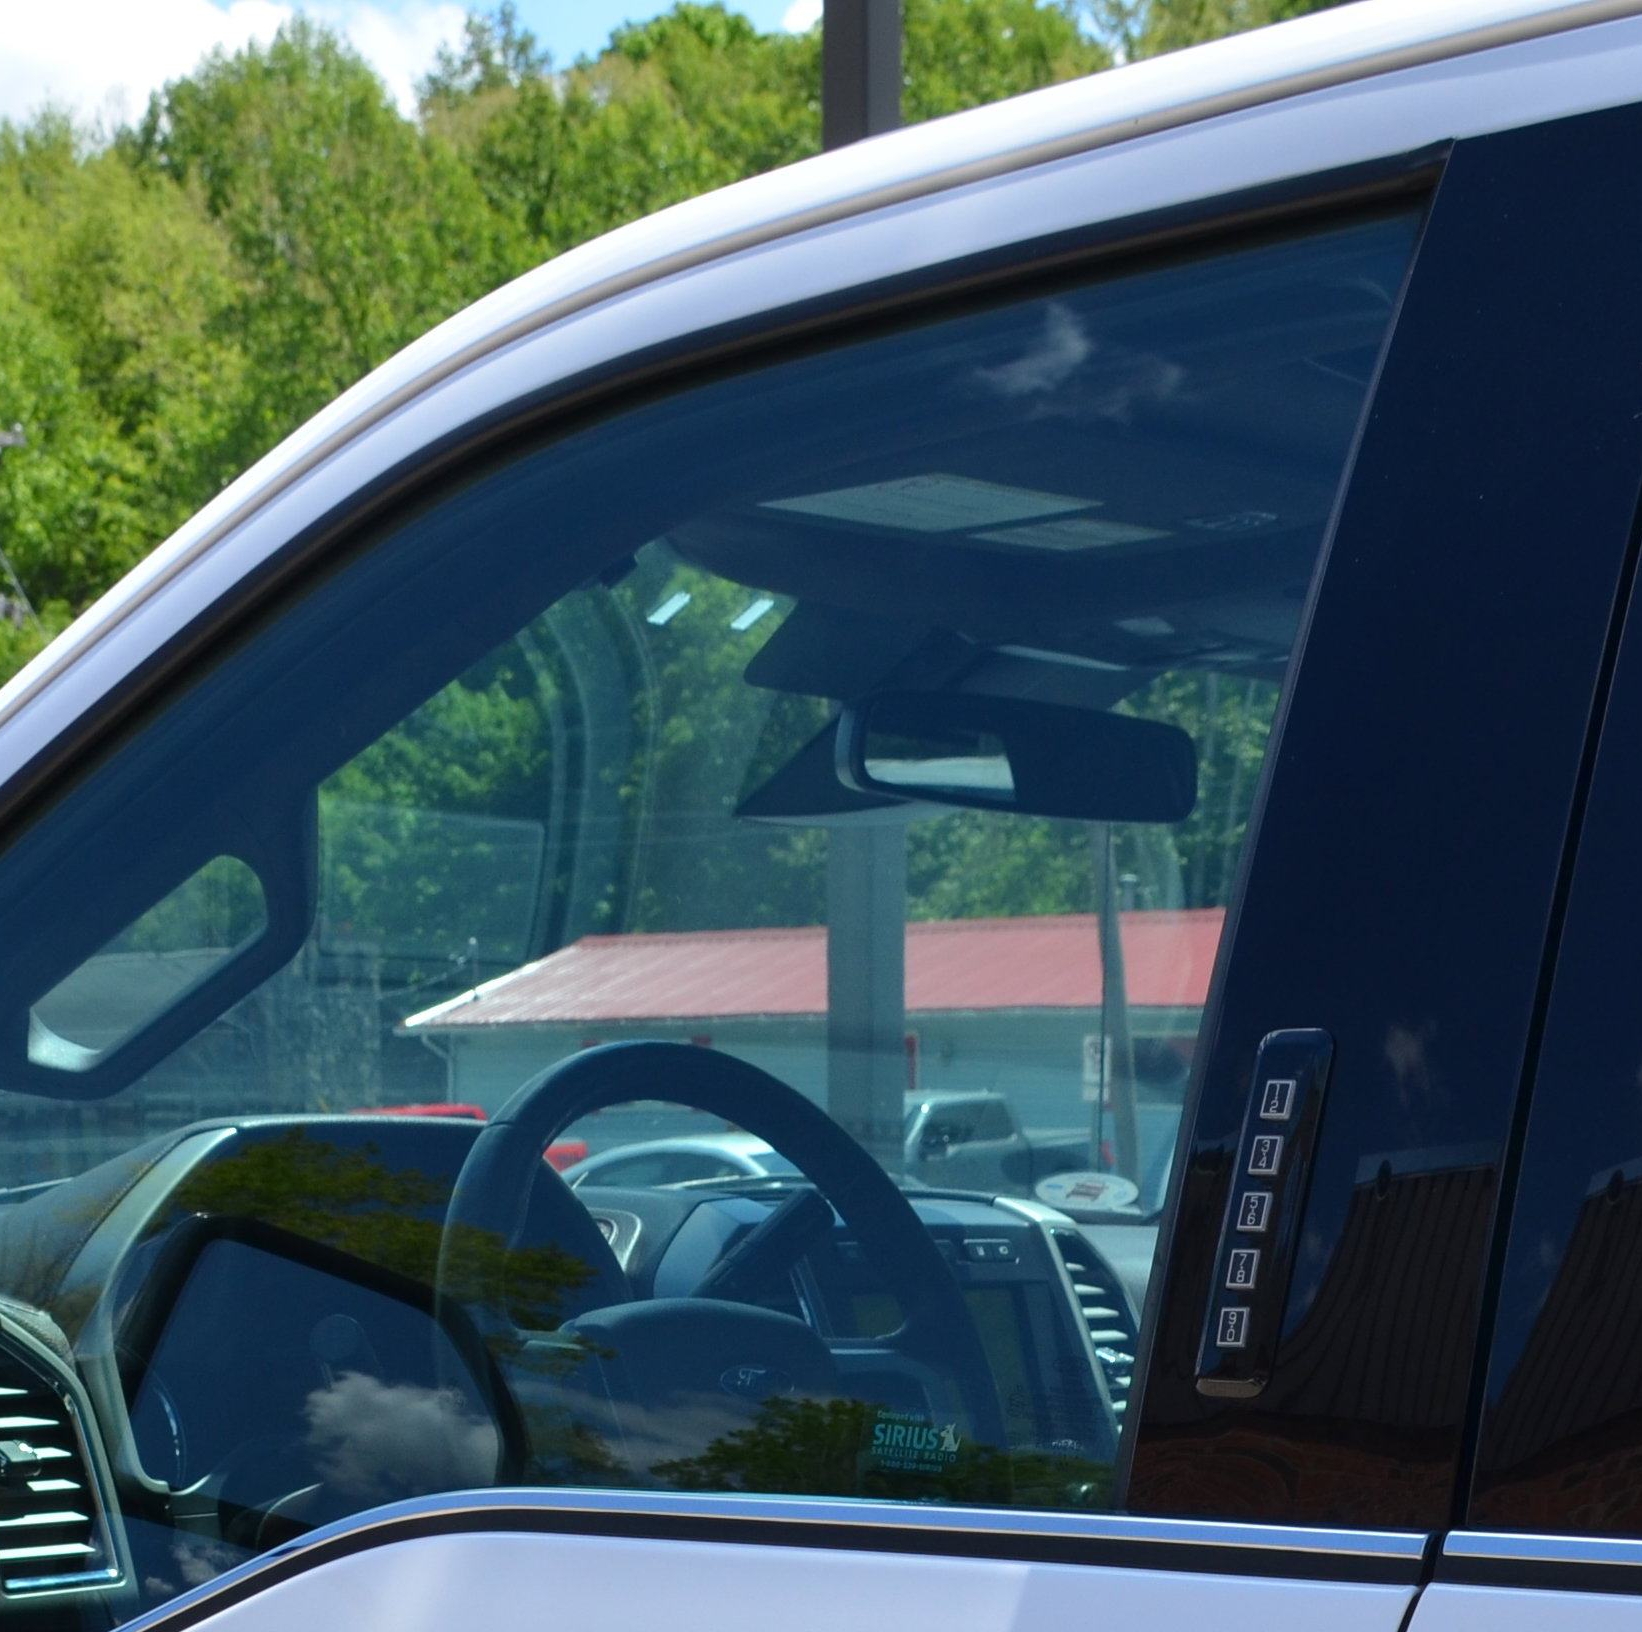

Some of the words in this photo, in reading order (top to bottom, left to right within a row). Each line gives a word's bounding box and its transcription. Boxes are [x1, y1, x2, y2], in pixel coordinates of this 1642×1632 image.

[873, 1423, 939, 1450] SIRIUS
[871, 1446, 919, 1459] SATELLITE
[924, 1451, 957, 1462] RADIO
